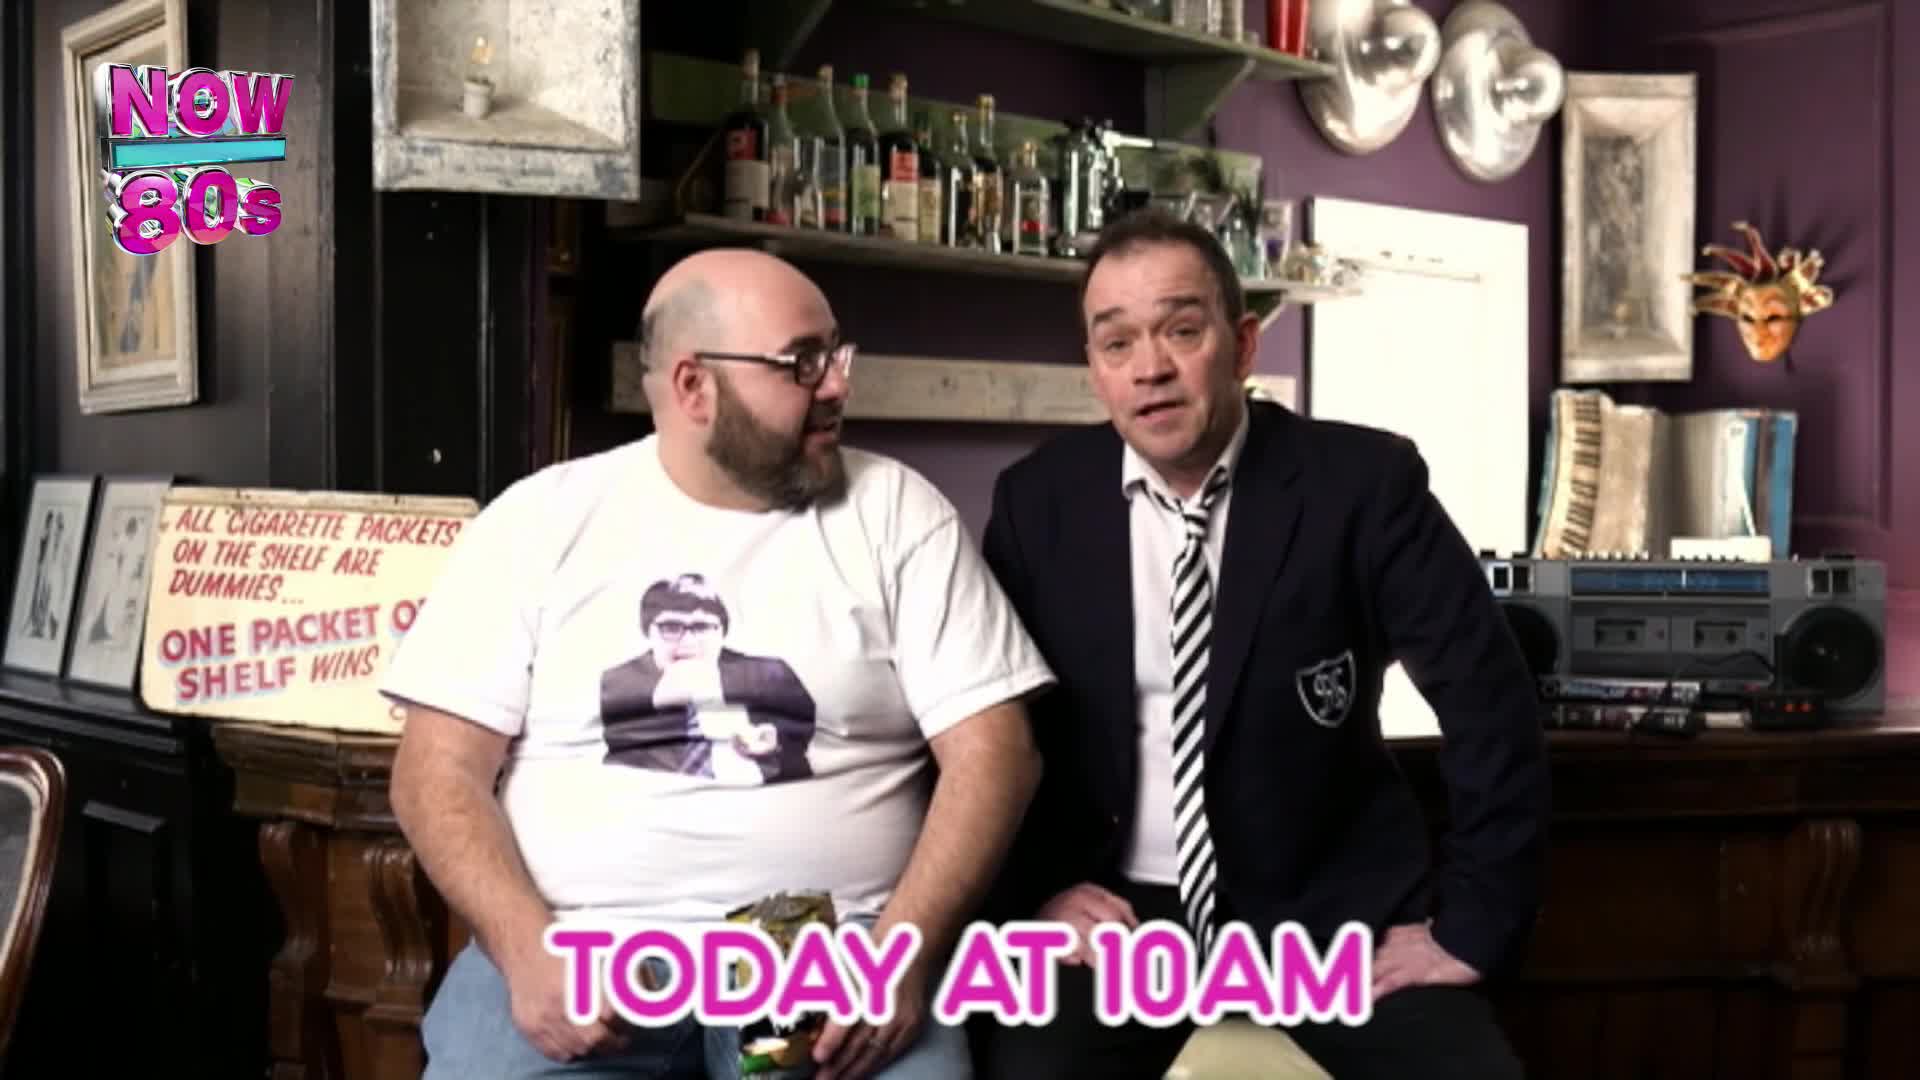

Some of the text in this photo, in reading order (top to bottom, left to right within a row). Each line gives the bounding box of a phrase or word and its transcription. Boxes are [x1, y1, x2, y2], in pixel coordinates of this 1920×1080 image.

[175, 507, 215, 533] ALL
[356, 515, 461, 547] PACKETS
[172, 538, 384, 575] ON THE SHELF ARE
[160, 597, 427, 663] ONE PACKET O
[176, 644, 380, 700] SHELF WINS
